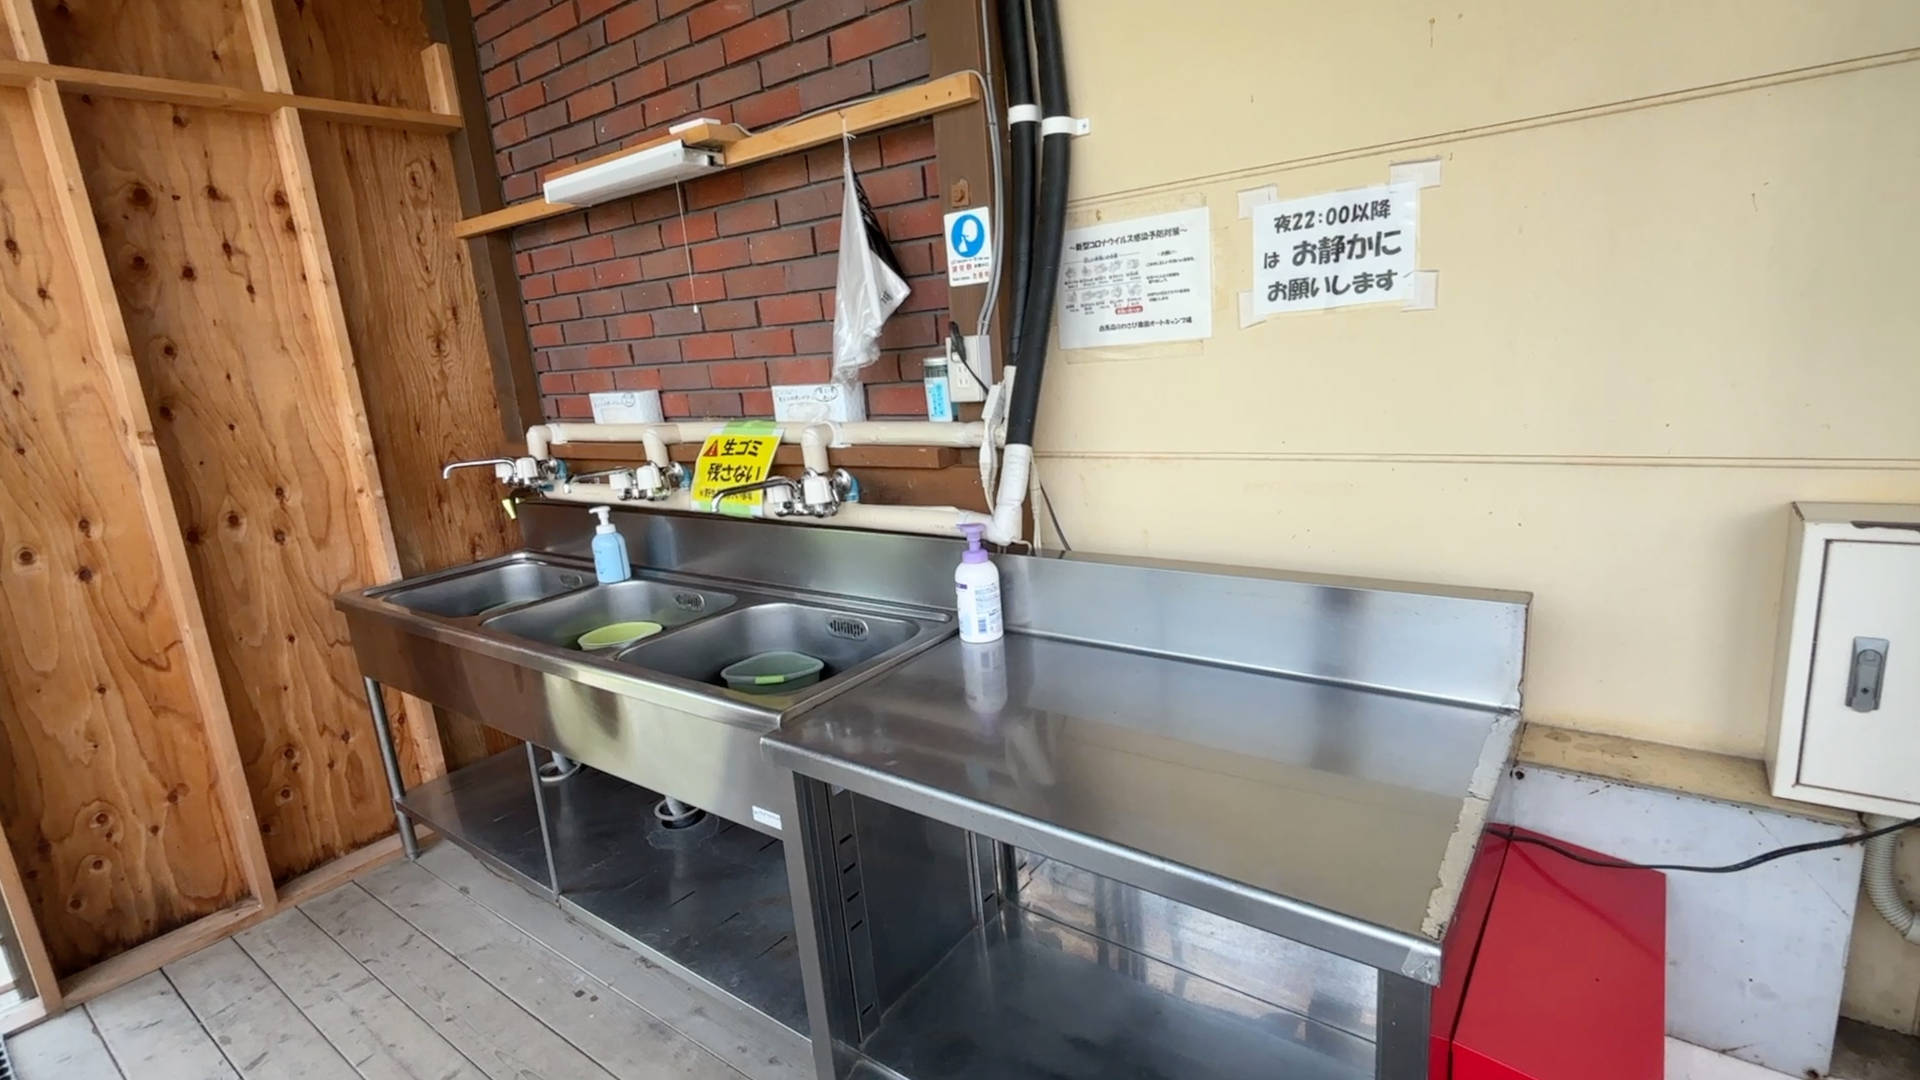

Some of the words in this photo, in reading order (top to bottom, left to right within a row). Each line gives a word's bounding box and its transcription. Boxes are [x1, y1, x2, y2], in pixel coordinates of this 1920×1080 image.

[1274, 199, 1391, 234] 夜22:00以降
[1264, 252, 1280, 269] は
[1292, 230, 1402, 266] お静かに
[1268, 268, 1398, 302] お願いします
[721, 438, 763, 457] 生ゴミ
[707, 463, 761, 482] 残さない
